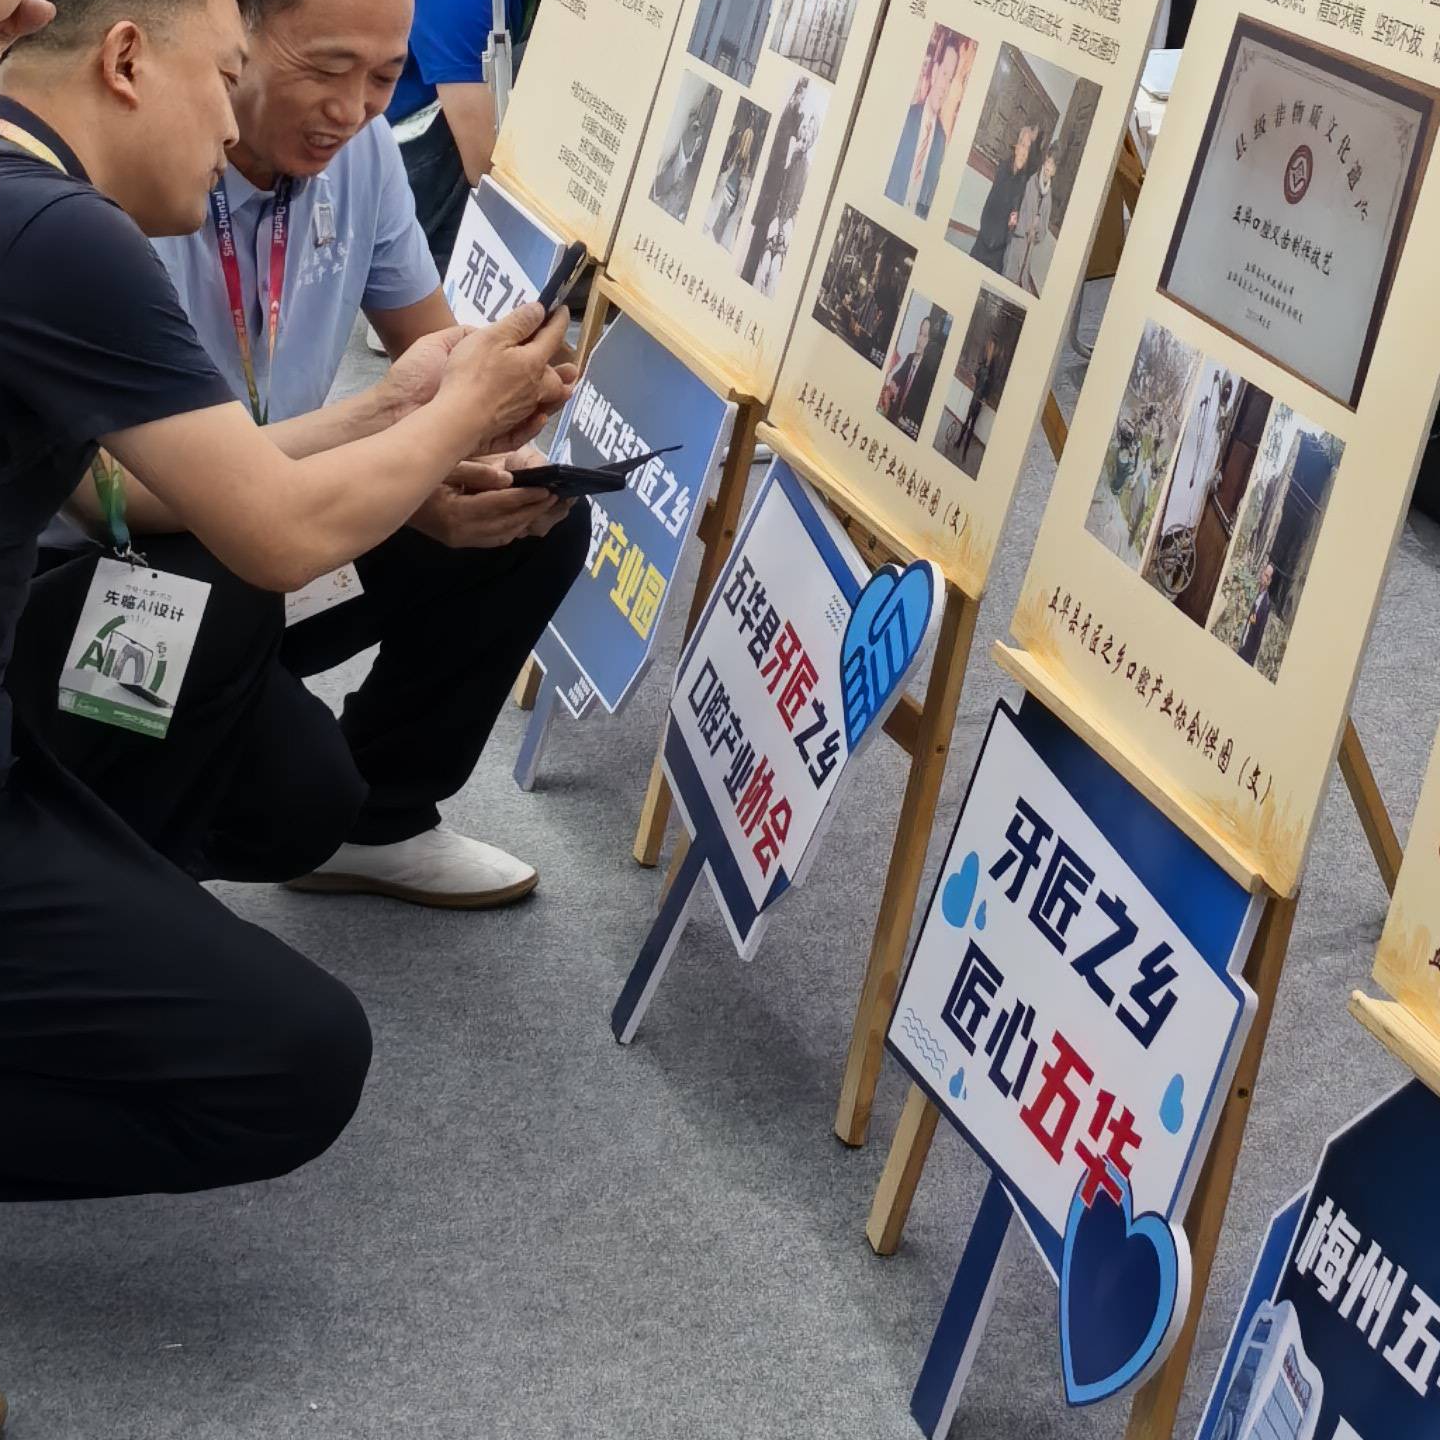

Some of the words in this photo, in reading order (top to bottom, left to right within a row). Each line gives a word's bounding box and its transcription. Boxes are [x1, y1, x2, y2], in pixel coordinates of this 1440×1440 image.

[583, 494, 668, 641] 腔产业园
[722, 554, 846, 793] 五华县牙匠之乡
[688, 657, 796, 879] 口腔产业协会
[987, 794, 1180, 1049] 牙匠之乡
[941, 940, 1143, 1209] 匠心五华
